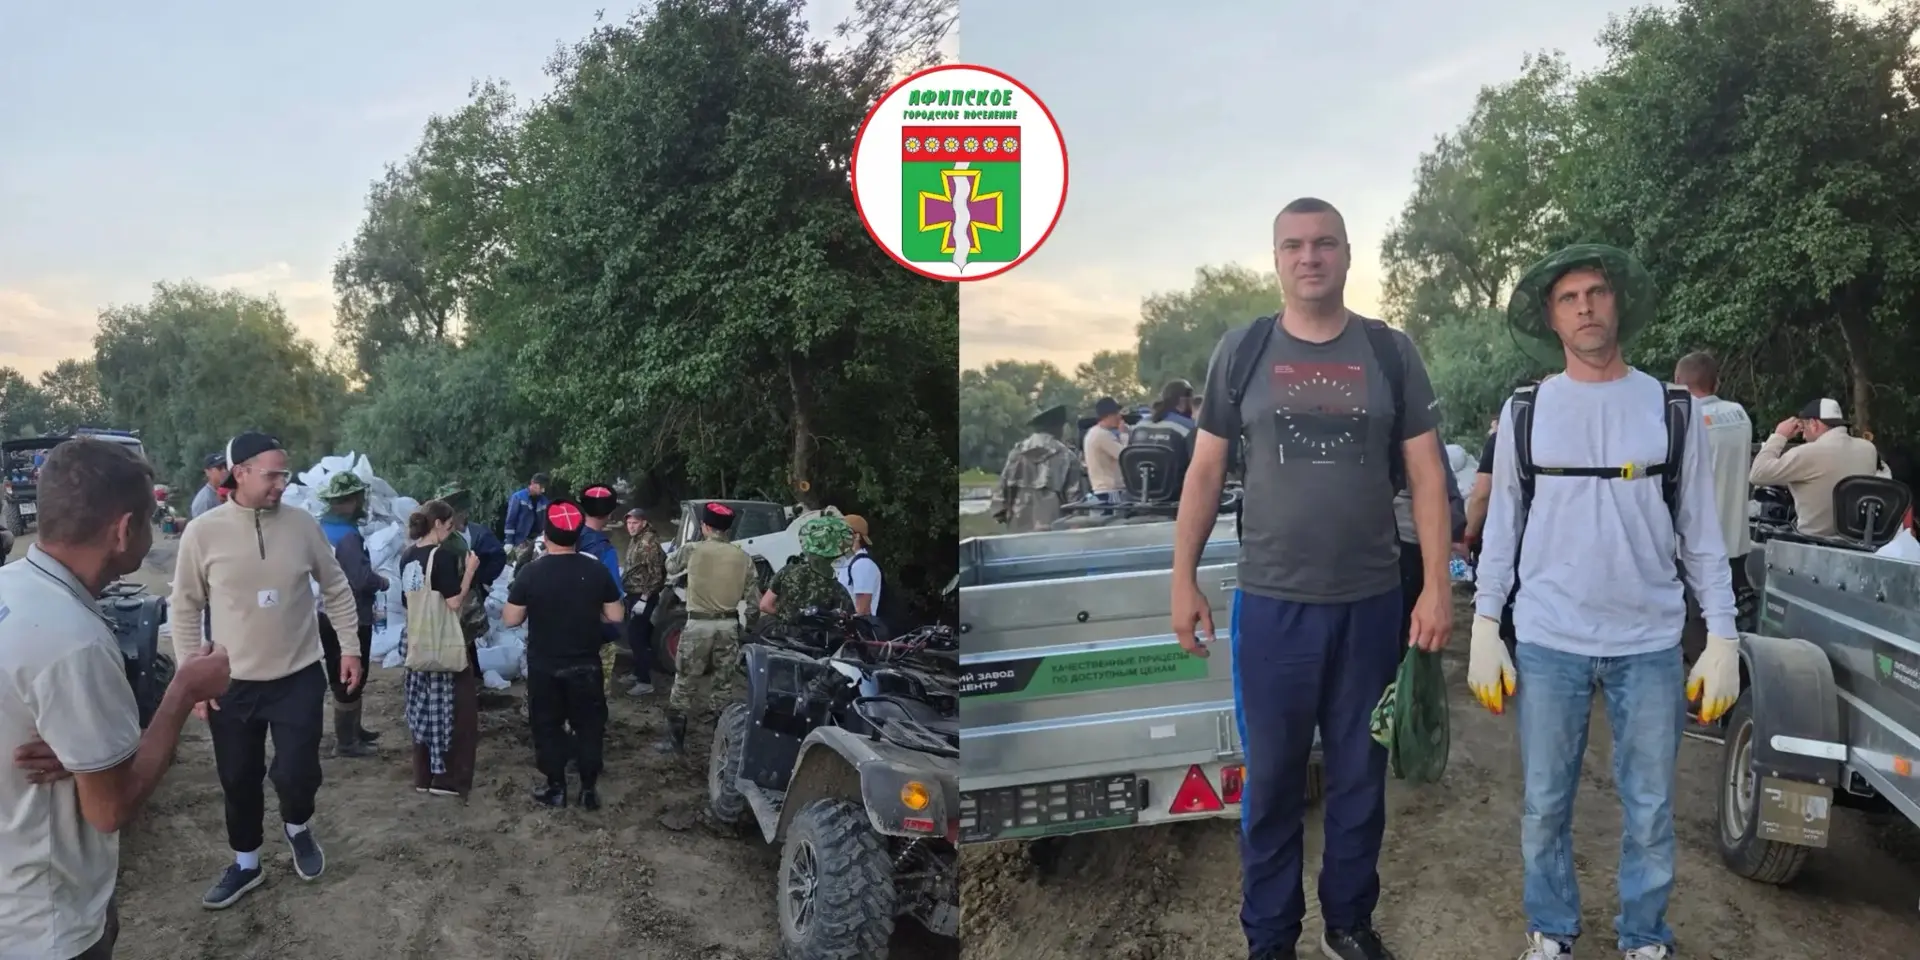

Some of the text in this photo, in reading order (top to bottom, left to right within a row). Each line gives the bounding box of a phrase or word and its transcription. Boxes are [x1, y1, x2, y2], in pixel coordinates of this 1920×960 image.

[1051, 651, 1190, 673] КАЧЕСТВЕННЫЕ ПРИЦЕПЫ
[977, 670, 1015, 681] ЗАВОД
[1052, 664, 1177, 684] ПО ДОСТУПНЫМ ЦЕНАМ
